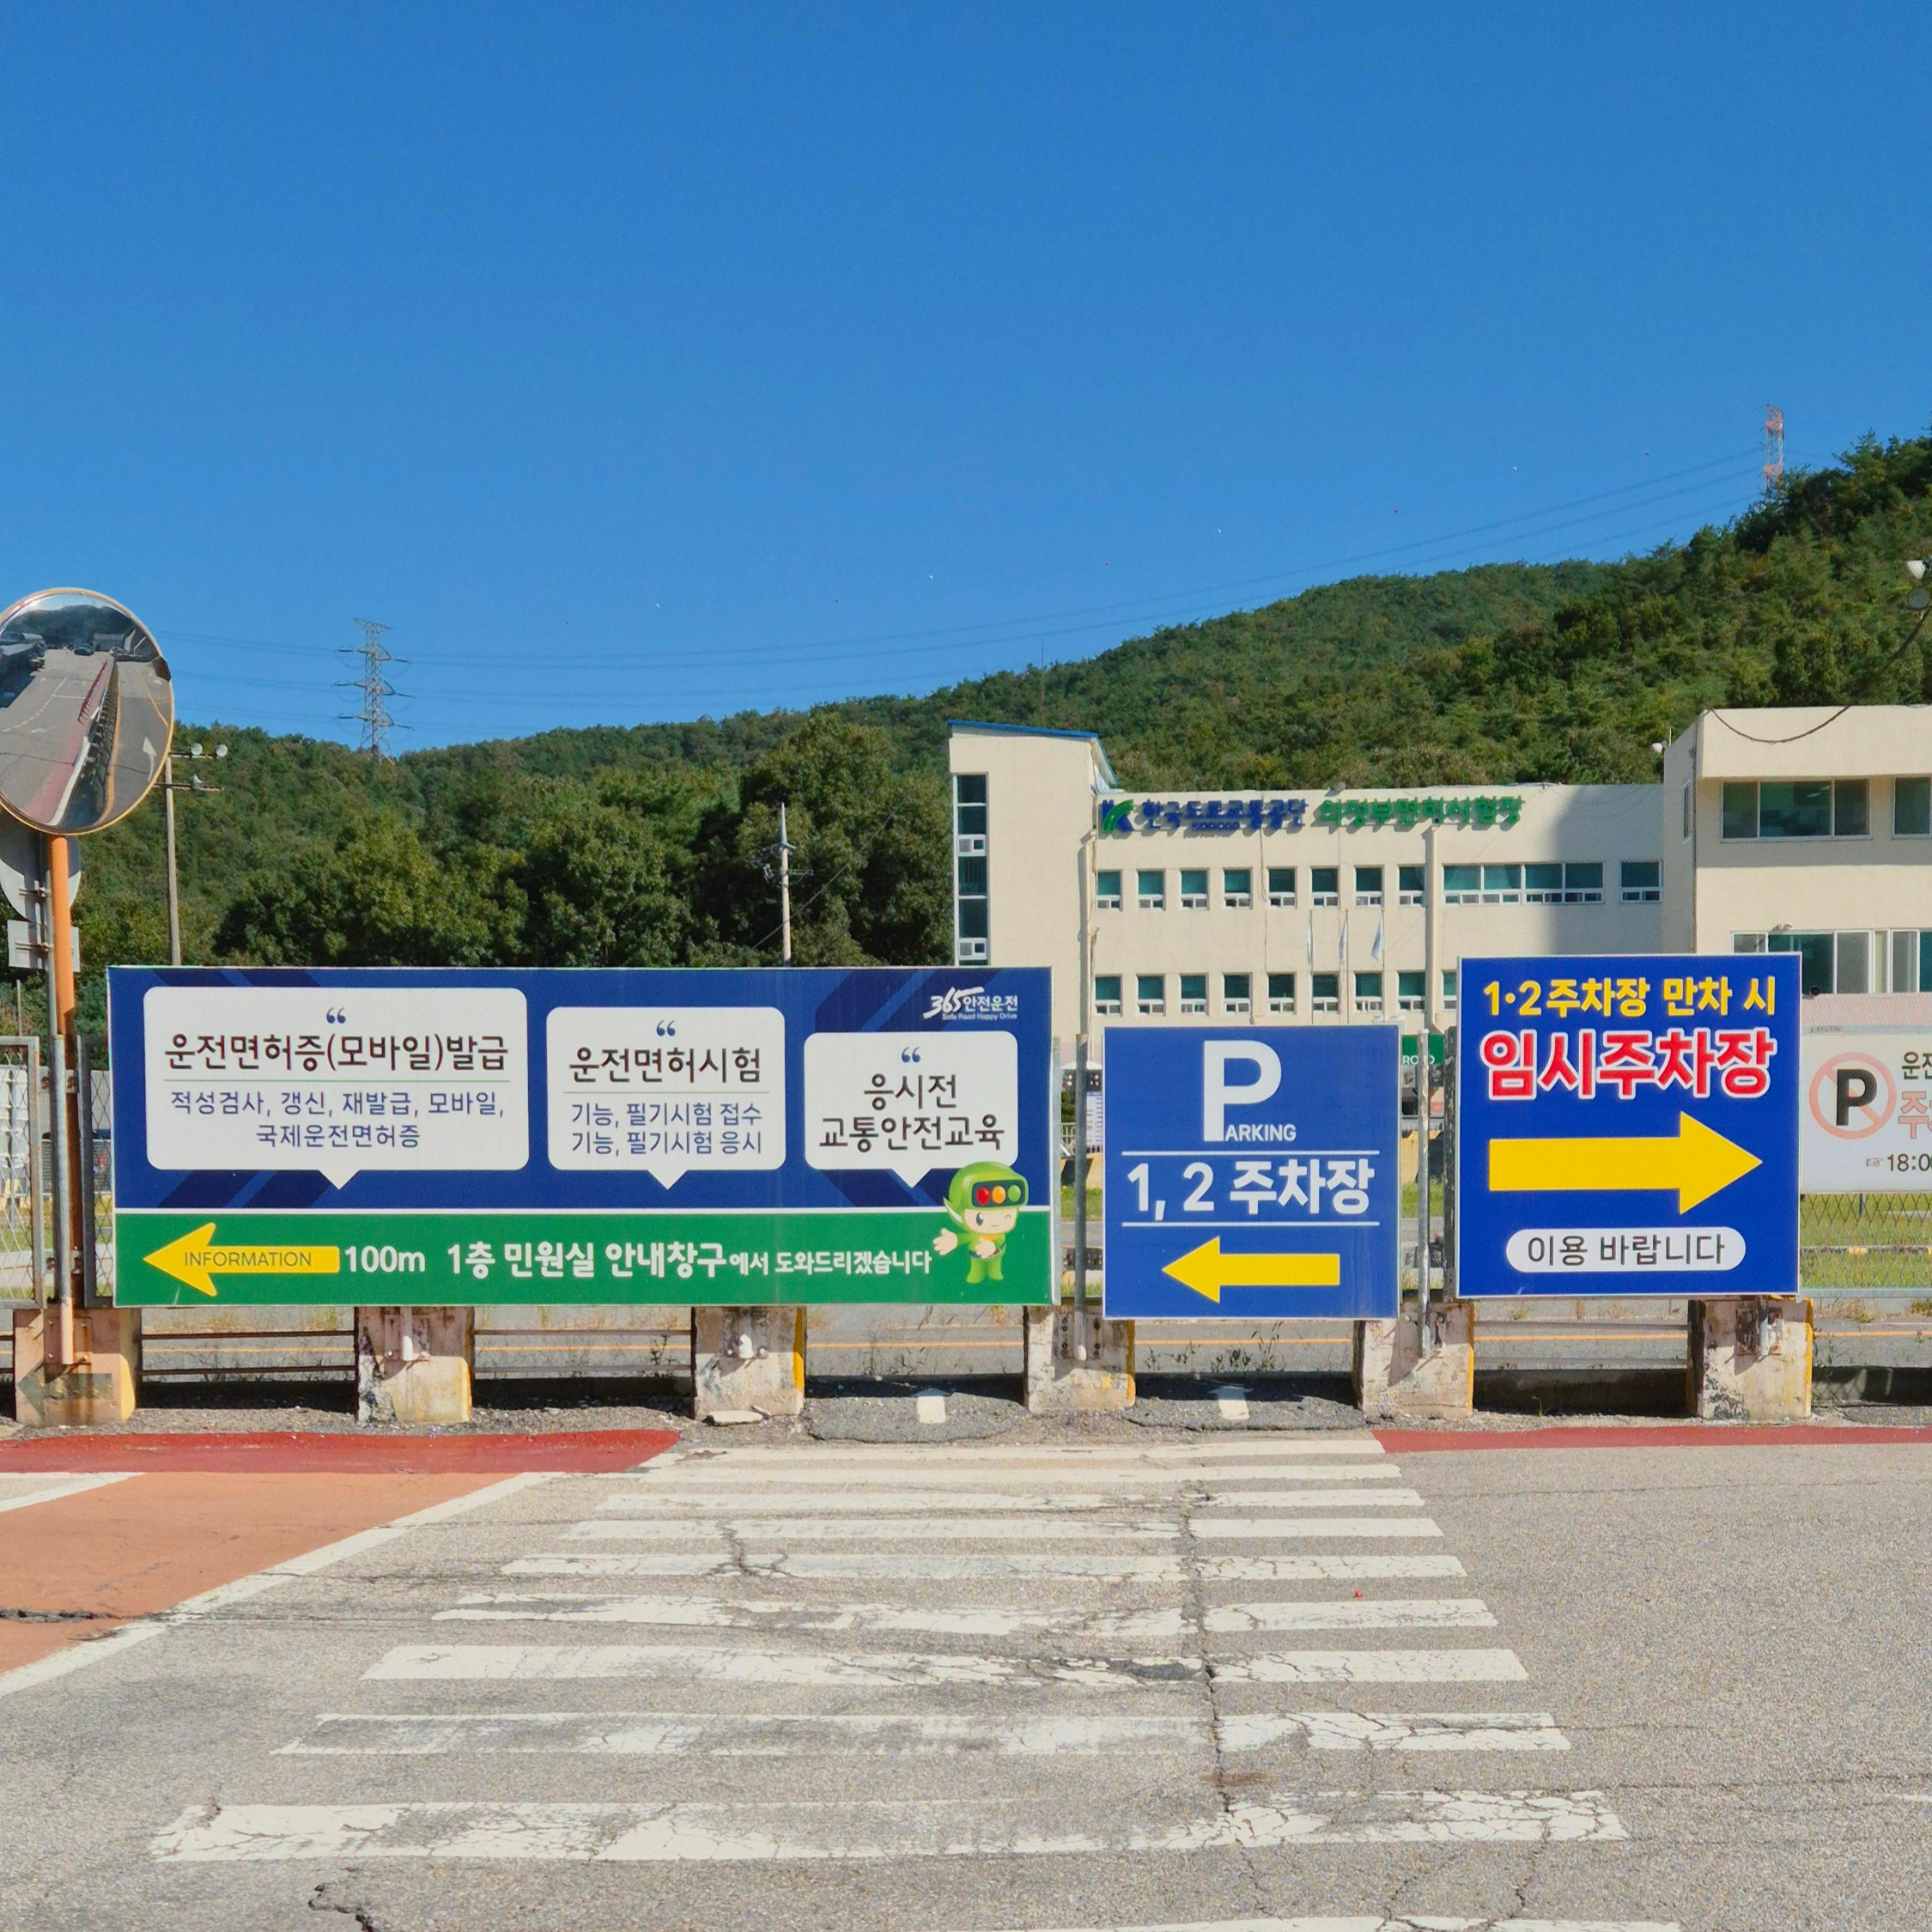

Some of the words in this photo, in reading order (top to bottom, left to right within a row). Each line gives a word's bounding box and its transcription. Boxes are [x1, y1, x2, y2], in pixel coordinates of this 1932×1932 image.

[1663, 976, 1732, 1015] 만차
[1743, 976, 1777, 1016] 시
[164, 1033, 508, 1072] 운전면허증(모바일)발급
[568, 1047, 762, 1084] 운전면허시험
[1480, 1027, 1777, 1101] 임시주차장
[170, 1091, 271, 1117] 적성검사,
[281, 1091, 333, 1117] 갱신,
[342, 1091, 418, 1117] 재발급,
[428, 1091, 504, 1117] 모바일,
[864, 1073, 957, 1111] 응시전
[1836, 1069, 1877, 1126] P
[571, 1102, 620, 1128] 기능,
[626, 1101, 713, 1127] 필기시험
[720, 1102, 762, 1127] 접수
[819, 1114, 1005, 1152] 교통안전교육
[1898, 1091, 1932, 1139] 주
[257, 1124, 422, 1148] 국제운전면허증
[571, 1131, 620, 1157] 기능,
[626, 1130, 713, 1156] 필기시험
[720, 1131, 762, 1155] 응시
[1886, 1153, 1932, 1172] 18:0
[1182, 1162, 1215, 1212] 2
[1230, 1158, 1375, 1215] 주차장
[184, 1251, 312, 1267] INFORMATION
[344, 1245, 425, 1273] 100m
[447, 1242, 495, 1279] 1층
[504, 1242, 594, 1278] 민원실
[775, 1251, 933, 1275] 도와드리겠습니다
[1527, 1235, 1589, 1267] 이용
[1600, 1234, 1726, 1266] 바랍니다
